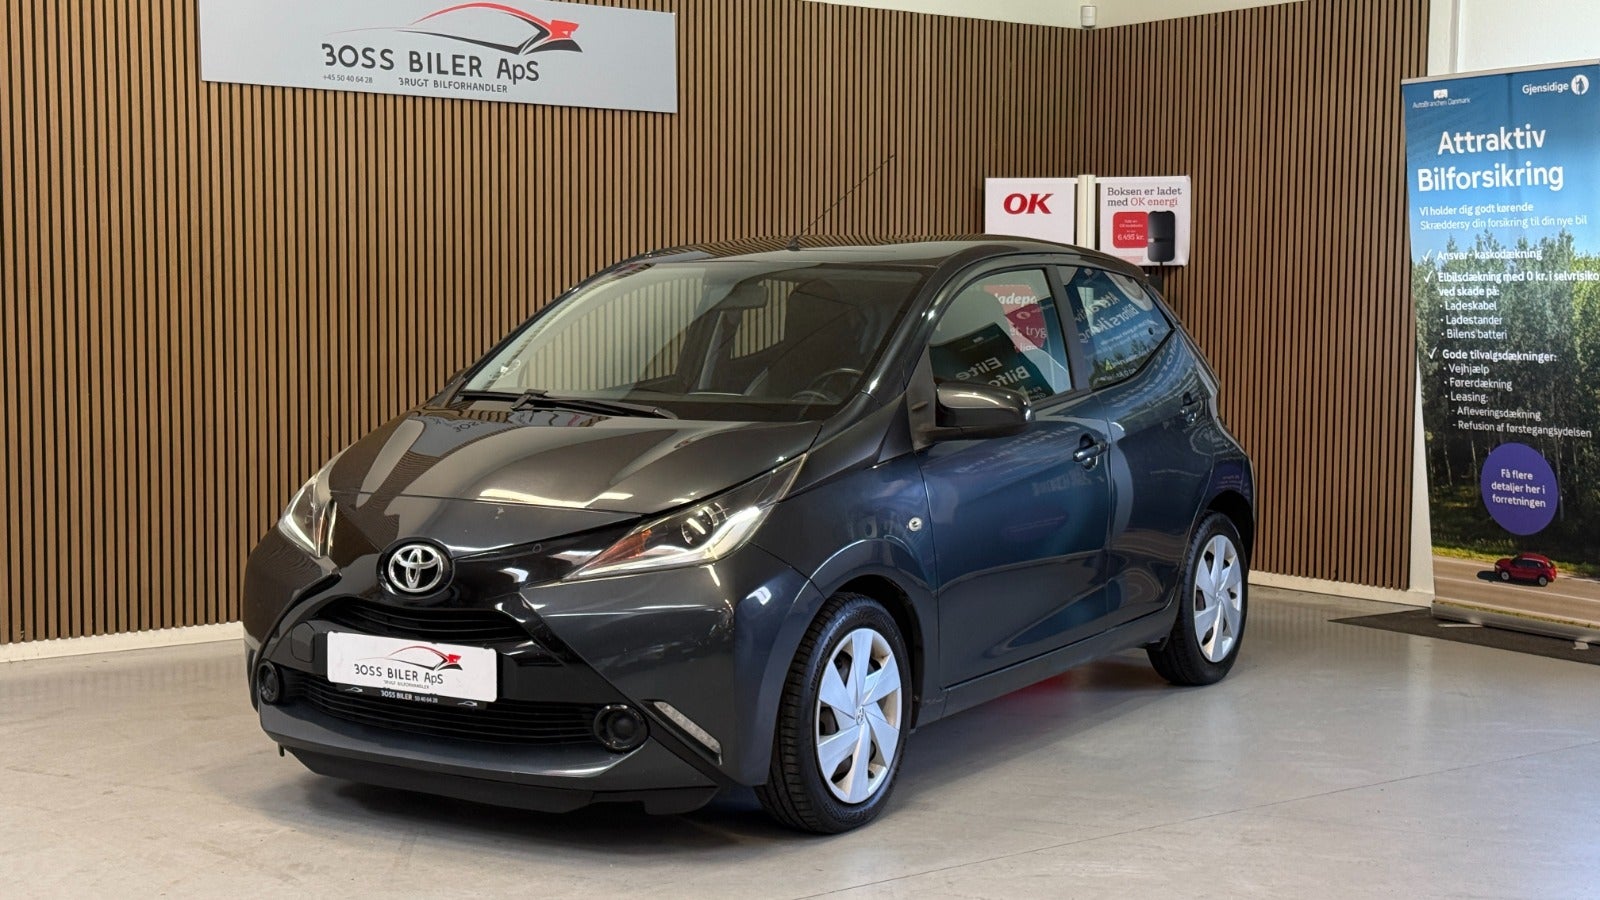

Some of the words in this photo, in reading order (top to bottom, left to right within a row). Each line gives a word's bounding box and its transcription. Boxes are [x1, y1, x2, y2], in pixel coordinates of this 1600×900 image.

[408, 50, 482, 78] BILER
[496, 58, 540, 85] ApS
[336, 74, 345, 82] 50
[433, 80, 508, 93] BILFORHANDLER
[1521, 81, 1569, 95] Gjensidige
[1437, 123, 1547, 155] Attraktiv
[1417, 160, 1565, 192] Bilforsikring
[1107, 187, 1142, 196] Boksen
[1157, 187, 1182, 196] ladet
[1003, 193, 1054, 215] OK
[1107, 198, 1128, 206] med
[1130, 197, 1145, 206] OK
[1147, 197, 1178, 208] energi
[1419, 206, 1428, 217] Vi
[1430, 205, 1457, 216] holder
[1458, 204, 1473, 217] dig
[1475, 204, 1495, 217] godt
[1497, 202, 1534, 213] kørende
[1420, 218, 1470, 231] Skræddersy
[1472, 217, 1486, 228] din
[1488, 216, 1528, 229] forsikring
[1530, 216, 1540, 226] til
[1541, 215, 1555, 226] din
[1556, 216, 1573, 228] nye
[1575, 214, 1587, 225] bil
[1475, 249, 1543, 261] kaskodækning
[1438, 271, 1501, 284] Elbilsdækning
[1502, 270, 1523, 282] med
[1526, 271, 1533, 281] 0
[1535, 271, 1548, 282] kr.
[1553, 271, 1600, 282] selvrisiko
[1439, 286, 1455, 297] ved
[1457, 286, 1484, 297] skade
[1486, 286, 1500, 298] på:
[1445, 301, 1497, 311] Ladeskabel
[1446, 315, 1503, 326] Ladestander
[1025, 326, 1047, 339] tryg
[1447, 329, 1476, 339] Bilens
[1477, 329, 1508, 340] batteri
[1442, 349, 1468, 360] Gode
[1470, 350, 1557, 363] tilvalgsdækninger:
[1448, 363, 1490, 375] Vejhjælp
[1449, 377, 1513, 392] Førerdækning
[1450, 391, 1489, 404] Leasing:
[1456, 406, 1542, 422] Afleveringsdækning
[1458, 420, 1495, 432] Refusion
[1496, 422, 1505, 432] af
[1506, 423, 1592, 440] førstegangsydelsen
[1500, 468, 1511, 479] Få
[1512, 469, 1533, 480] flere
[1491, 481, 1524, 494] detaljer
[1525, 483, 1540, 494] her
[1542, 484, 1546, 494] i
[1492, 493, 1546, 509] forretningen
[387, 667, 419, 682] BILER
[424, 672, 444, 686] ApS
[396, 691, 412, 701] BILER
